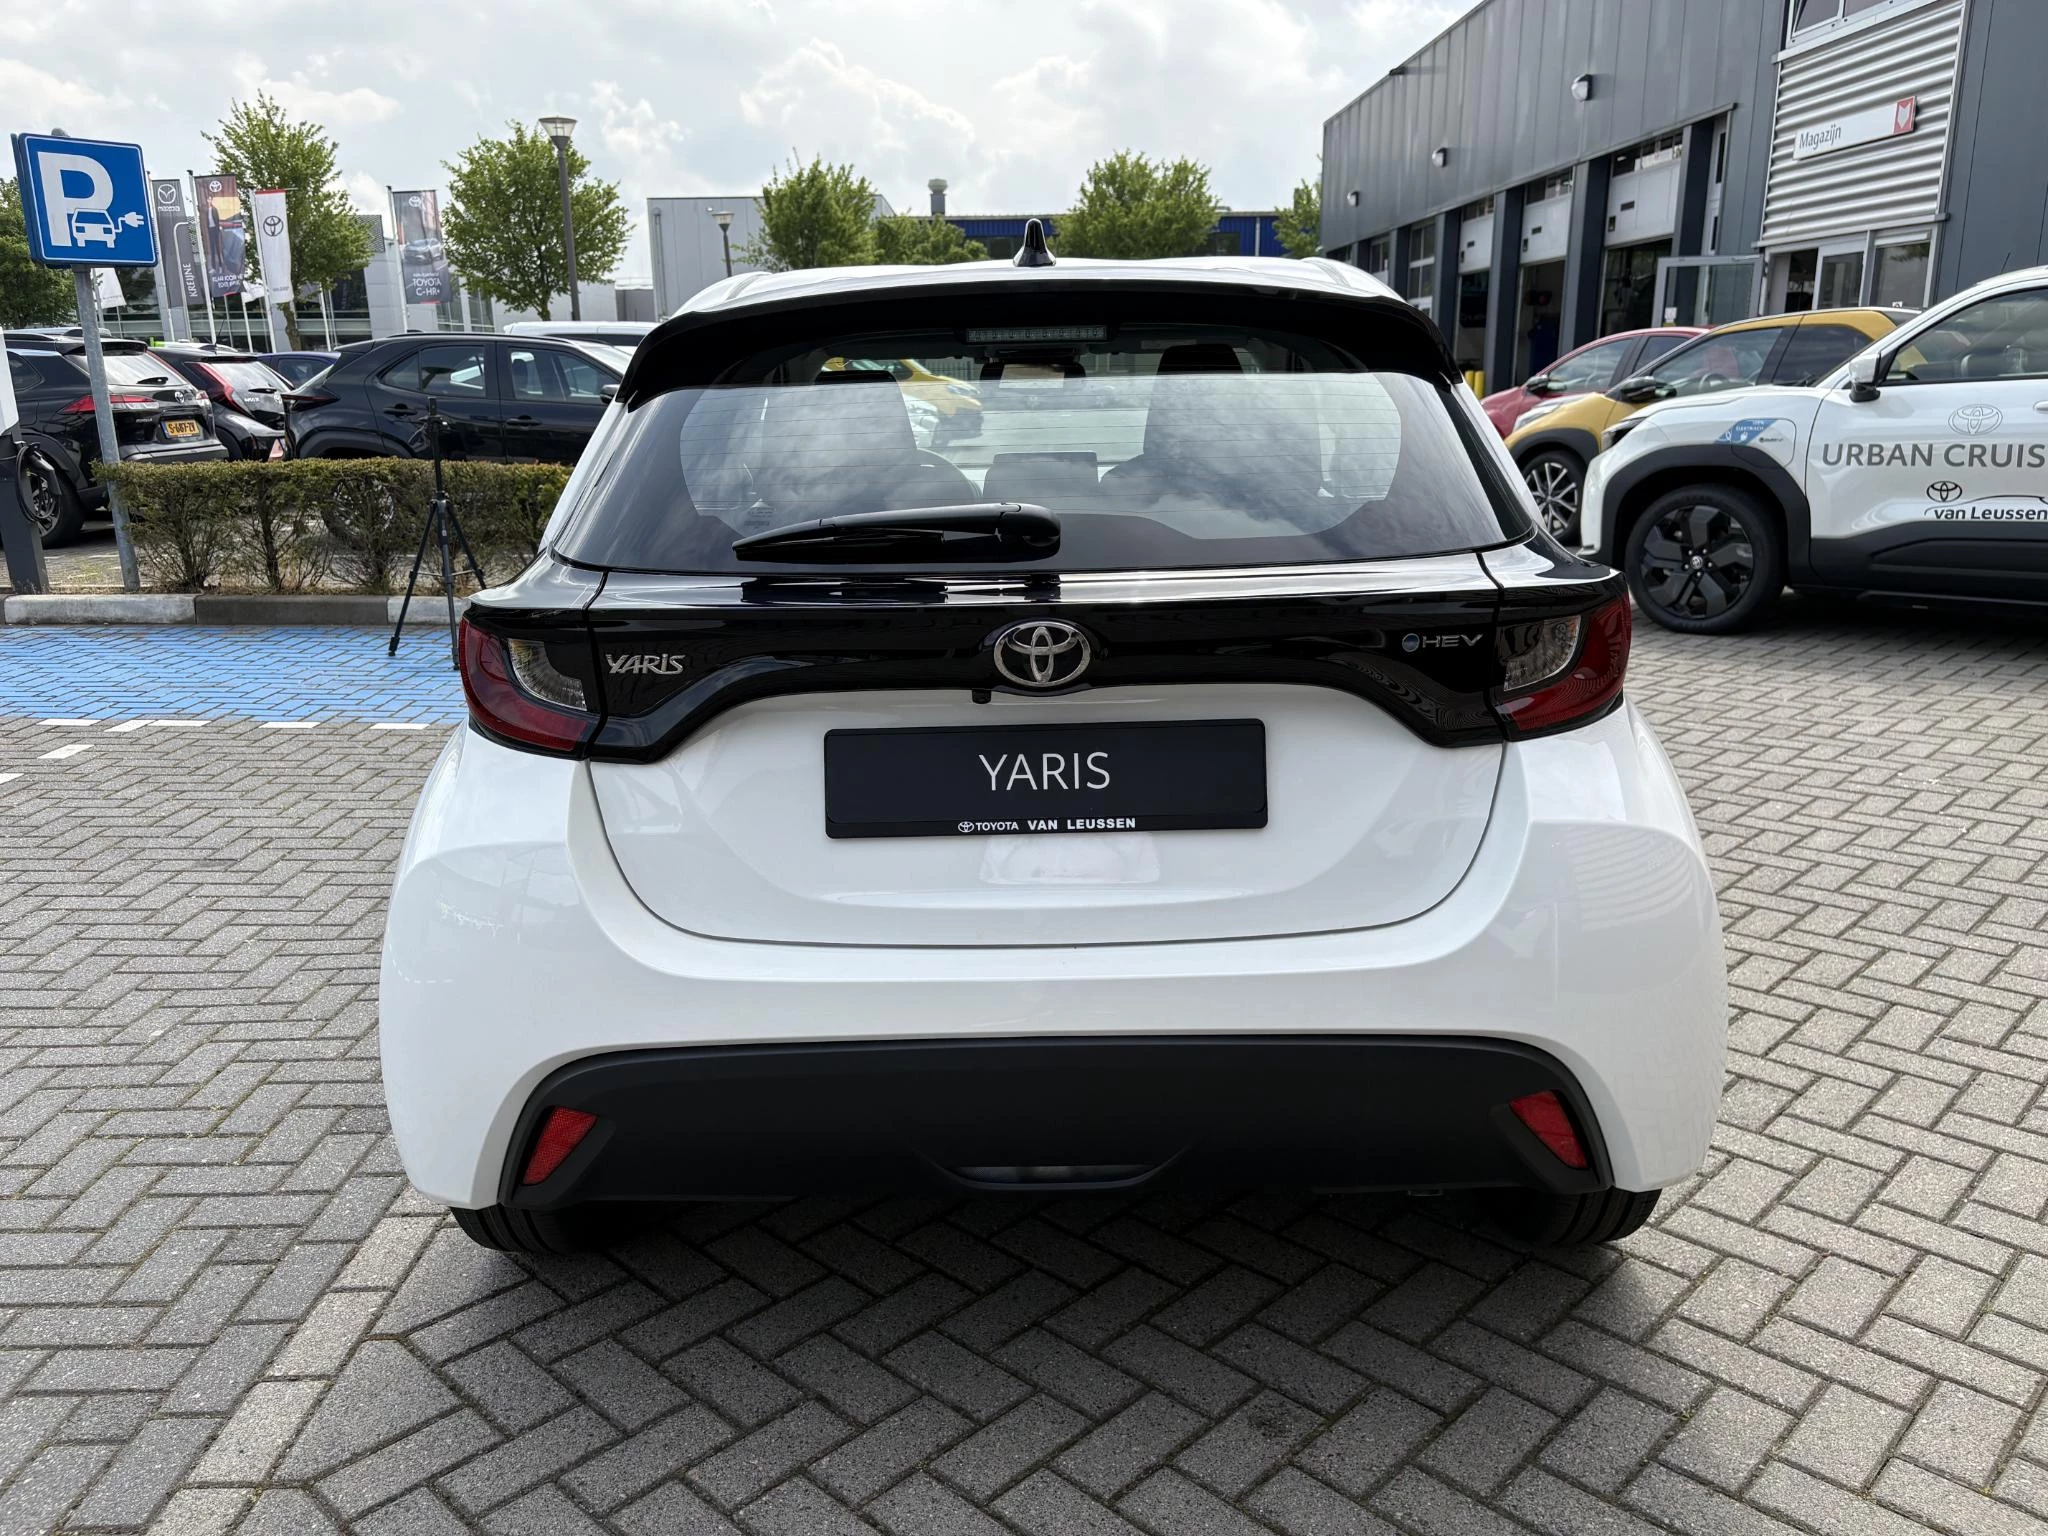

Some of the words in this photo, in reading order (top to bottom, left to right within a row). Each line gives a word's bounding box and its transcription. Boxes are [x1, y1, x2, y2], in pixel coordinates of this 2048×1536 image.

[1800, 123, 1842, 150] Magazijn
[37, 151, 114, 247] P
[412, 278, 442, 287] TOYOTA
[1822, 443, 1934, 467] URBAN
[1943, 443, 2046, 468] CRUIS
[1934, 509, 1966, 520] van
[1970, 506, 2048, 521] Leussen
[1422, 634, 1483, 648] HEV
[605, 653, 686, 675] YARIS
[978, 751, 1111, 791] YARIS
[975, 821, 1020, 832] TOYOTA
[1027, 819, 1058, 831] VAN
[1066, 817, 1136, 830] LEUSSEN
